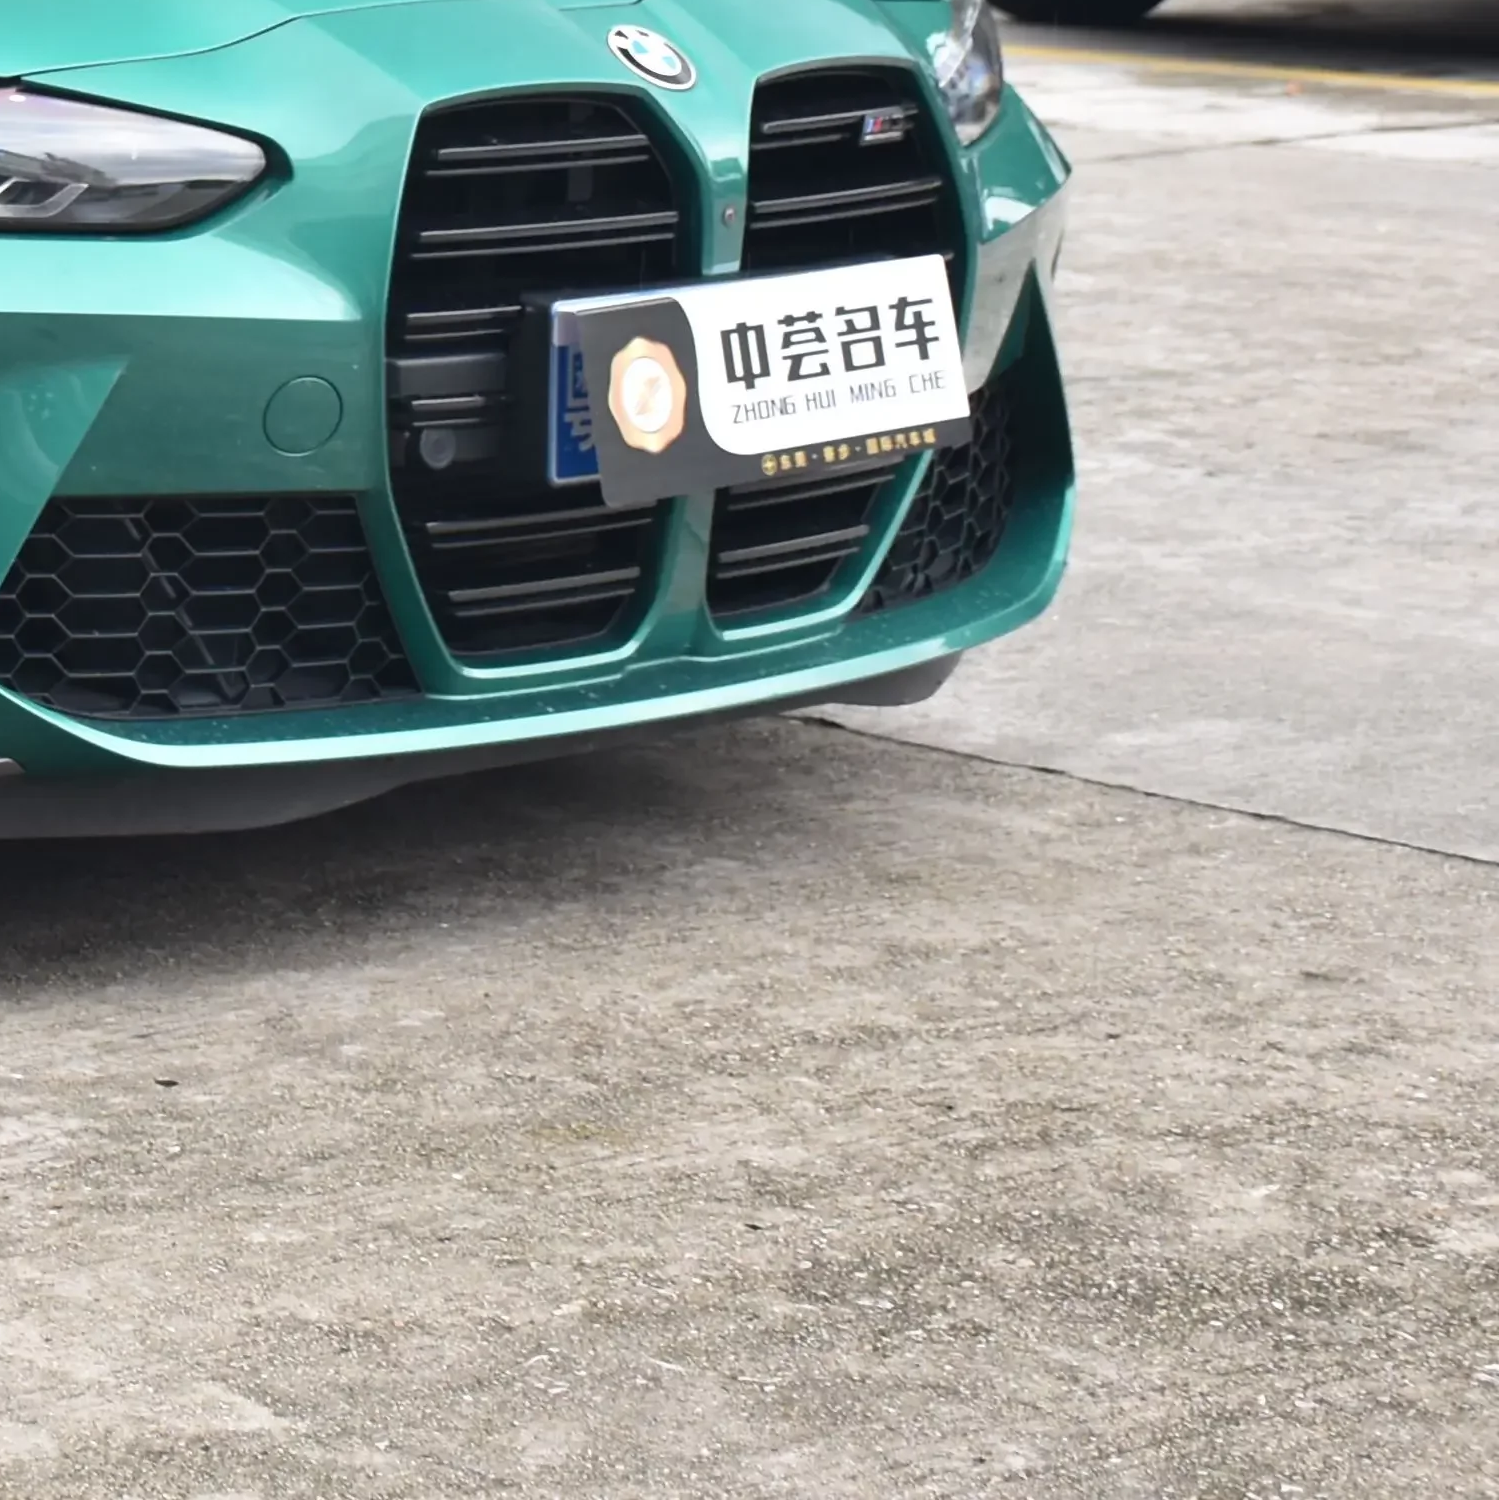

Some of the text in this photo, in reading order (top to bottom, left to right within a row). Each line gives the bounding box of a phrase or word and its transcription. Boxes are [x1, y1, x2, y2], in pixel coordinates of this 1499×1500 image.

[720, 296, 940, 390] 中荟名车
[732, 370, 947, 425] ZHONG HUI MING CHE
